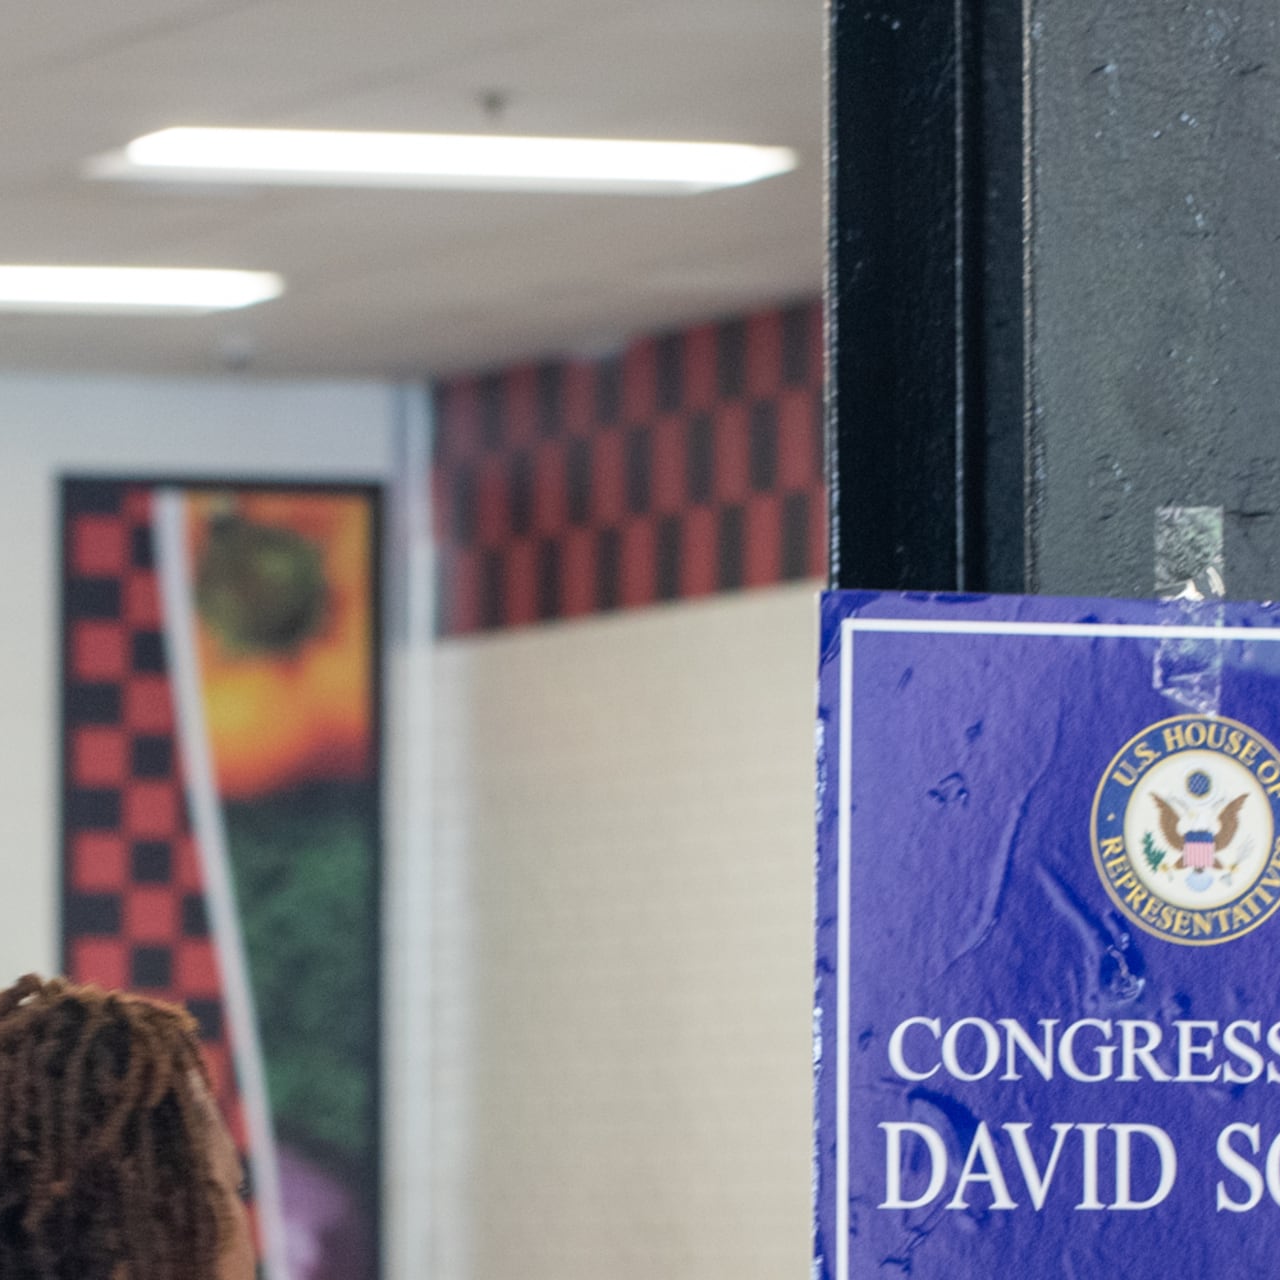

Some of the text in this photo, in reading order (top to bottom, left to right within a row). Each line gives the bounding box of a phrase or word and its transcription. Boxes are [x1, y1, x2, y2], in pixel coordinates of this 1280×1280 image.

[1112, 741, 1162, 787] U.S.
[1162, 721, 1262, 766] HOUSE
[877, 1120, 1177, 1211] DAVID
